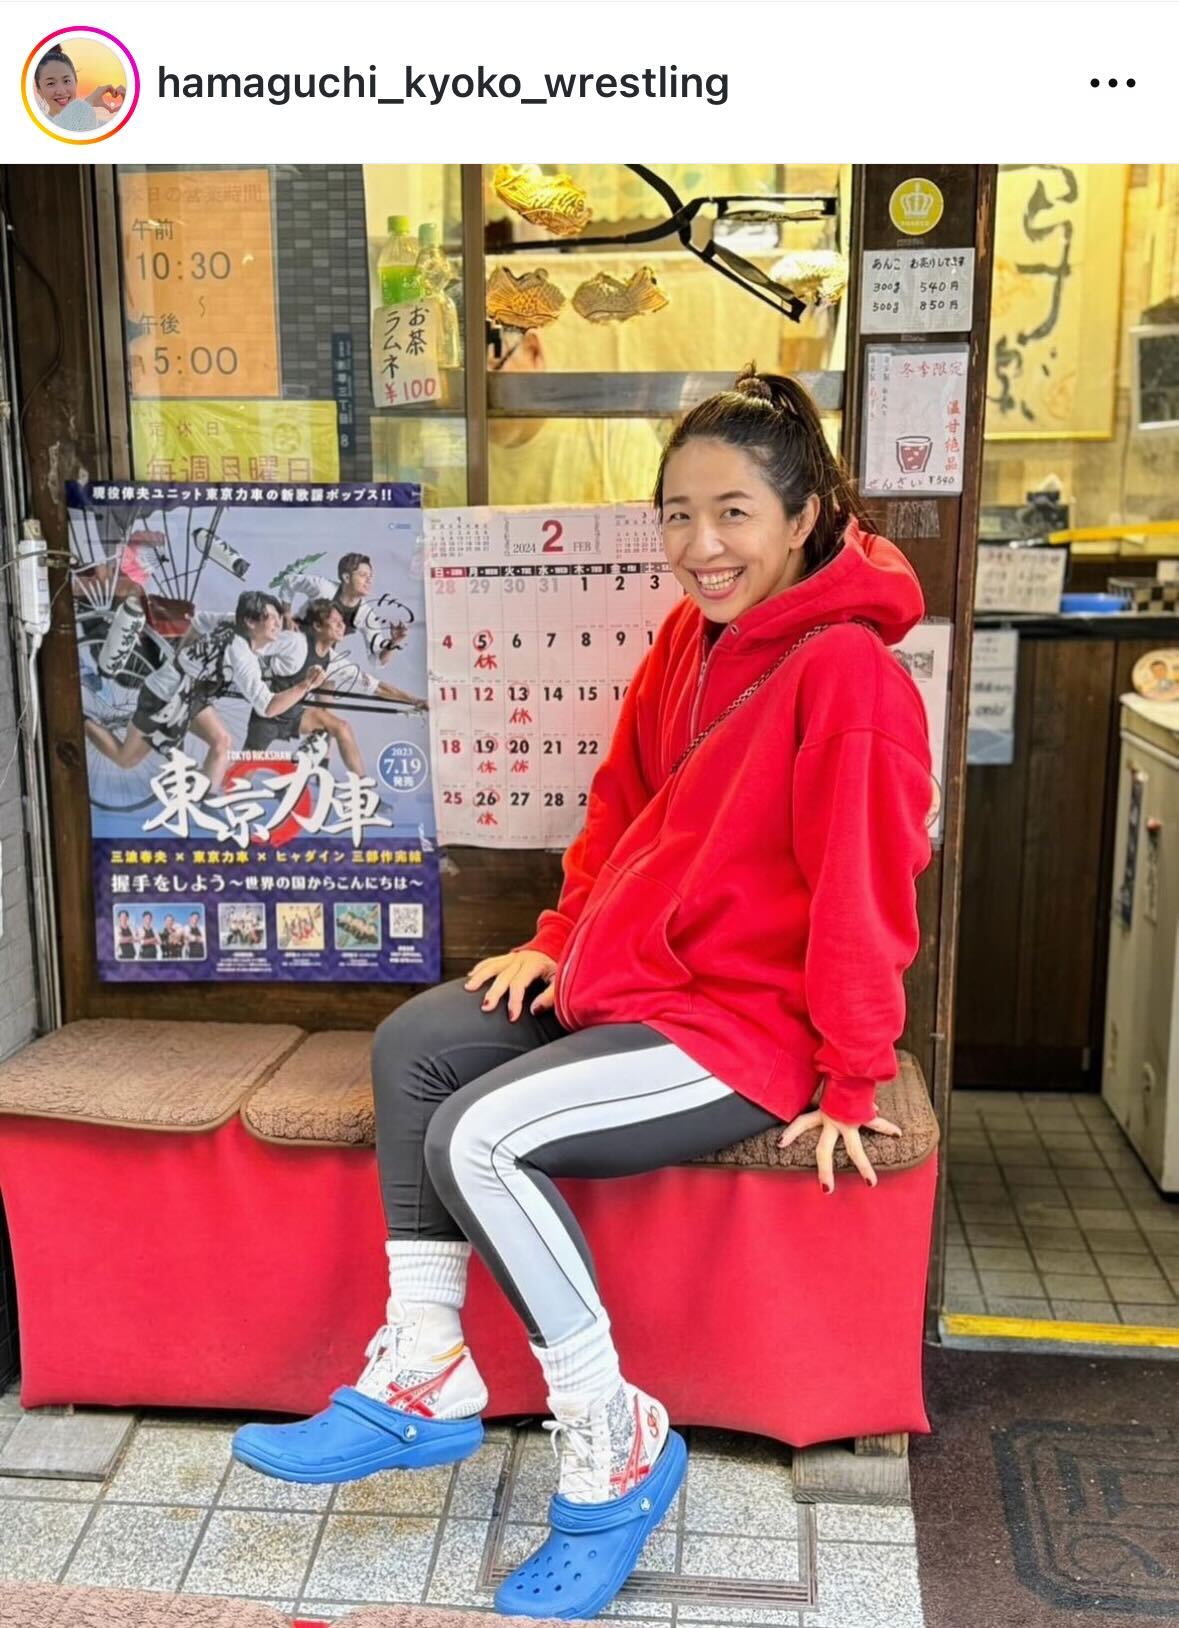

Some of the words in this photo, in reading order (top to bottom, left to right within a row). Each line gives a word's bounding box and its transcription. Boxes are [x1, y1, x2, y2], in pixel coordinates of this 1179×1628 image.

[132, 218, 174, 240] 午前
[136, 251, 232, 281] 10:30
[871, 257, 901, 271] あんこ
[872, 281, 901, 294] 300g
[139, 312, 182, 335] 午後
[405, 306, 430, 356] お茶
[382, 310, 402, 380] ラムネ
[154, 346, 238, 375] 5:00
[901, 360, 965, 379] 冬季限定
[384, 377, 437, 403] ¥100
[150, 419, 220, 439] 定休日
[513, 542, 536, 554] 2024
[541, 519, 564, 553] 2
[573, 541, 591, 552] FEB
[503, 565, 515, 576] 火
[538, 565, 550, 575] 水
[573, 564, 586, 575] 木
[435, 580, 456, 594] 28
[470, 579, 490, 593] 29
[504, 579, 525, 592] 30
[539, 578, 559, 592] 31
[580, 577, 588, 591] 1
[615, 576, 625, 591] 2
[649, 575, 660, 590] 3
[442, 635, 453, 649] 4
[477, 634, 487, 649] 5
[512, 633, 522, 648] 6
[546, 633, 556, 648] 7
[581, 632, 591, 647] 8
[616, 631, 626, 647] 9
[647, 631, 654, 646] 1
[474, 654, 498, 670] 休
[439, 687, 458, 700] 11
[474, 687, 494, 700] 12
[508, 687, 529, 701] 13
[543, 687, 564, 701] 14
[578, 686, 598, 700] 15
[509, 707, 532, 725] 休
[226, 750, 250, 761] TOKYO
[391, 746, 414, 757] 2023
[442, 740, 461, 754] 18
[475, 739, 495, 754] 19
[509, 739, 530, 754] 20
[543, 740, 562, 755] 21
[577, 740, 599, 755] 22
[383, 757, 422, 775] 7.19
[477, 760, 497, 774] 休
[511, 759, 529, 774] 休
[393, 776, 415, 788] 発売
[142, 746, 394, 850] 東京力車
[443, 791, 463, 805] 25
[475, 791, 497, 806] 26
[510, 792, 530, 806] 27
[544, 792, 564, 807] 28
[578, 792, 588, 806] 2
[476, 811, 498, 825] 休
[193, 851, 249, 864] 東京力車
[276, 851, 345, 863] ヒャダイン
